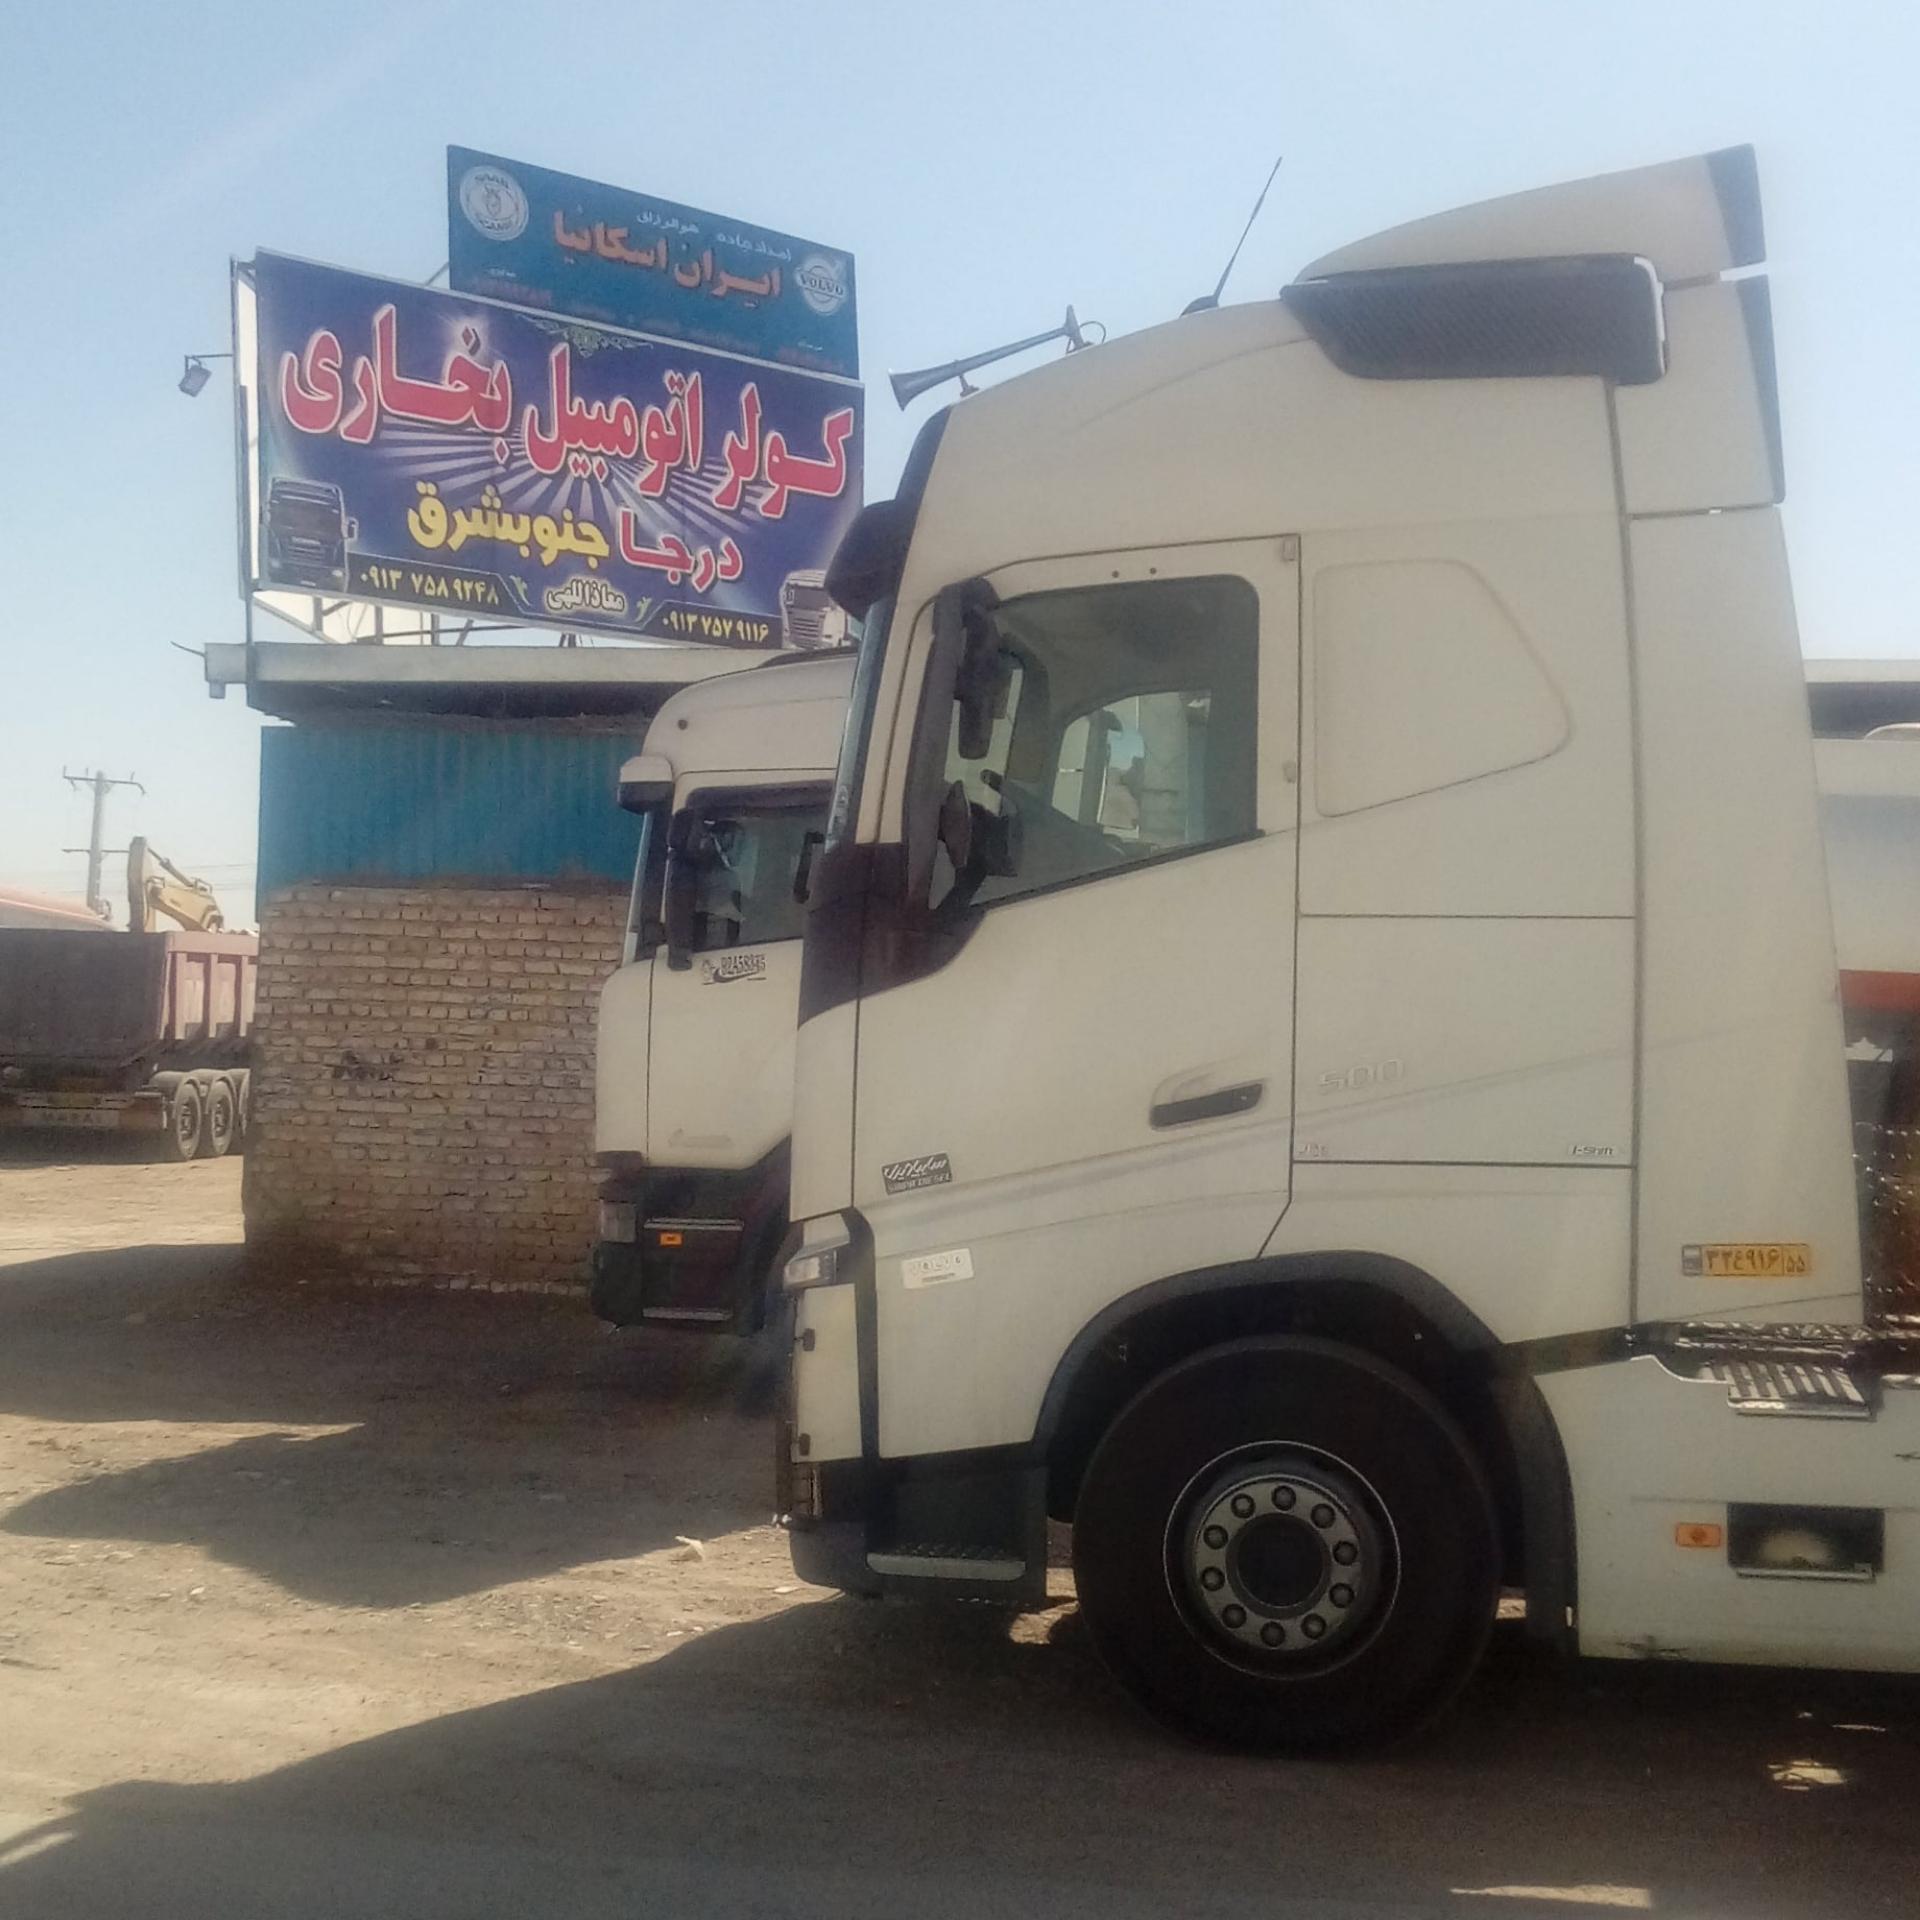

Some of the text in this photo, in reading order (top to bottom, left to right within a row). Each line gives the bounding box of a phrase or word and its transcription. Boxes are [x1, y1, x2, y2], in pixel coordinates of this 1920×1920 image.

[554, 204, 782, 309] ایران اسکانیا
[801, 273, 845, 295] VOLVO
[279, 303, 853, 519] کولر اتومبیل بخاری
[618, 506, 743, 593] درجا
[411, 572, 448, 598] ۷۵۸
[662, 610, 769, 643] ۰۹۱۳ ۷۵۷ ۹۱۱۶
[1319, 1058, 1405, 1091] 500
